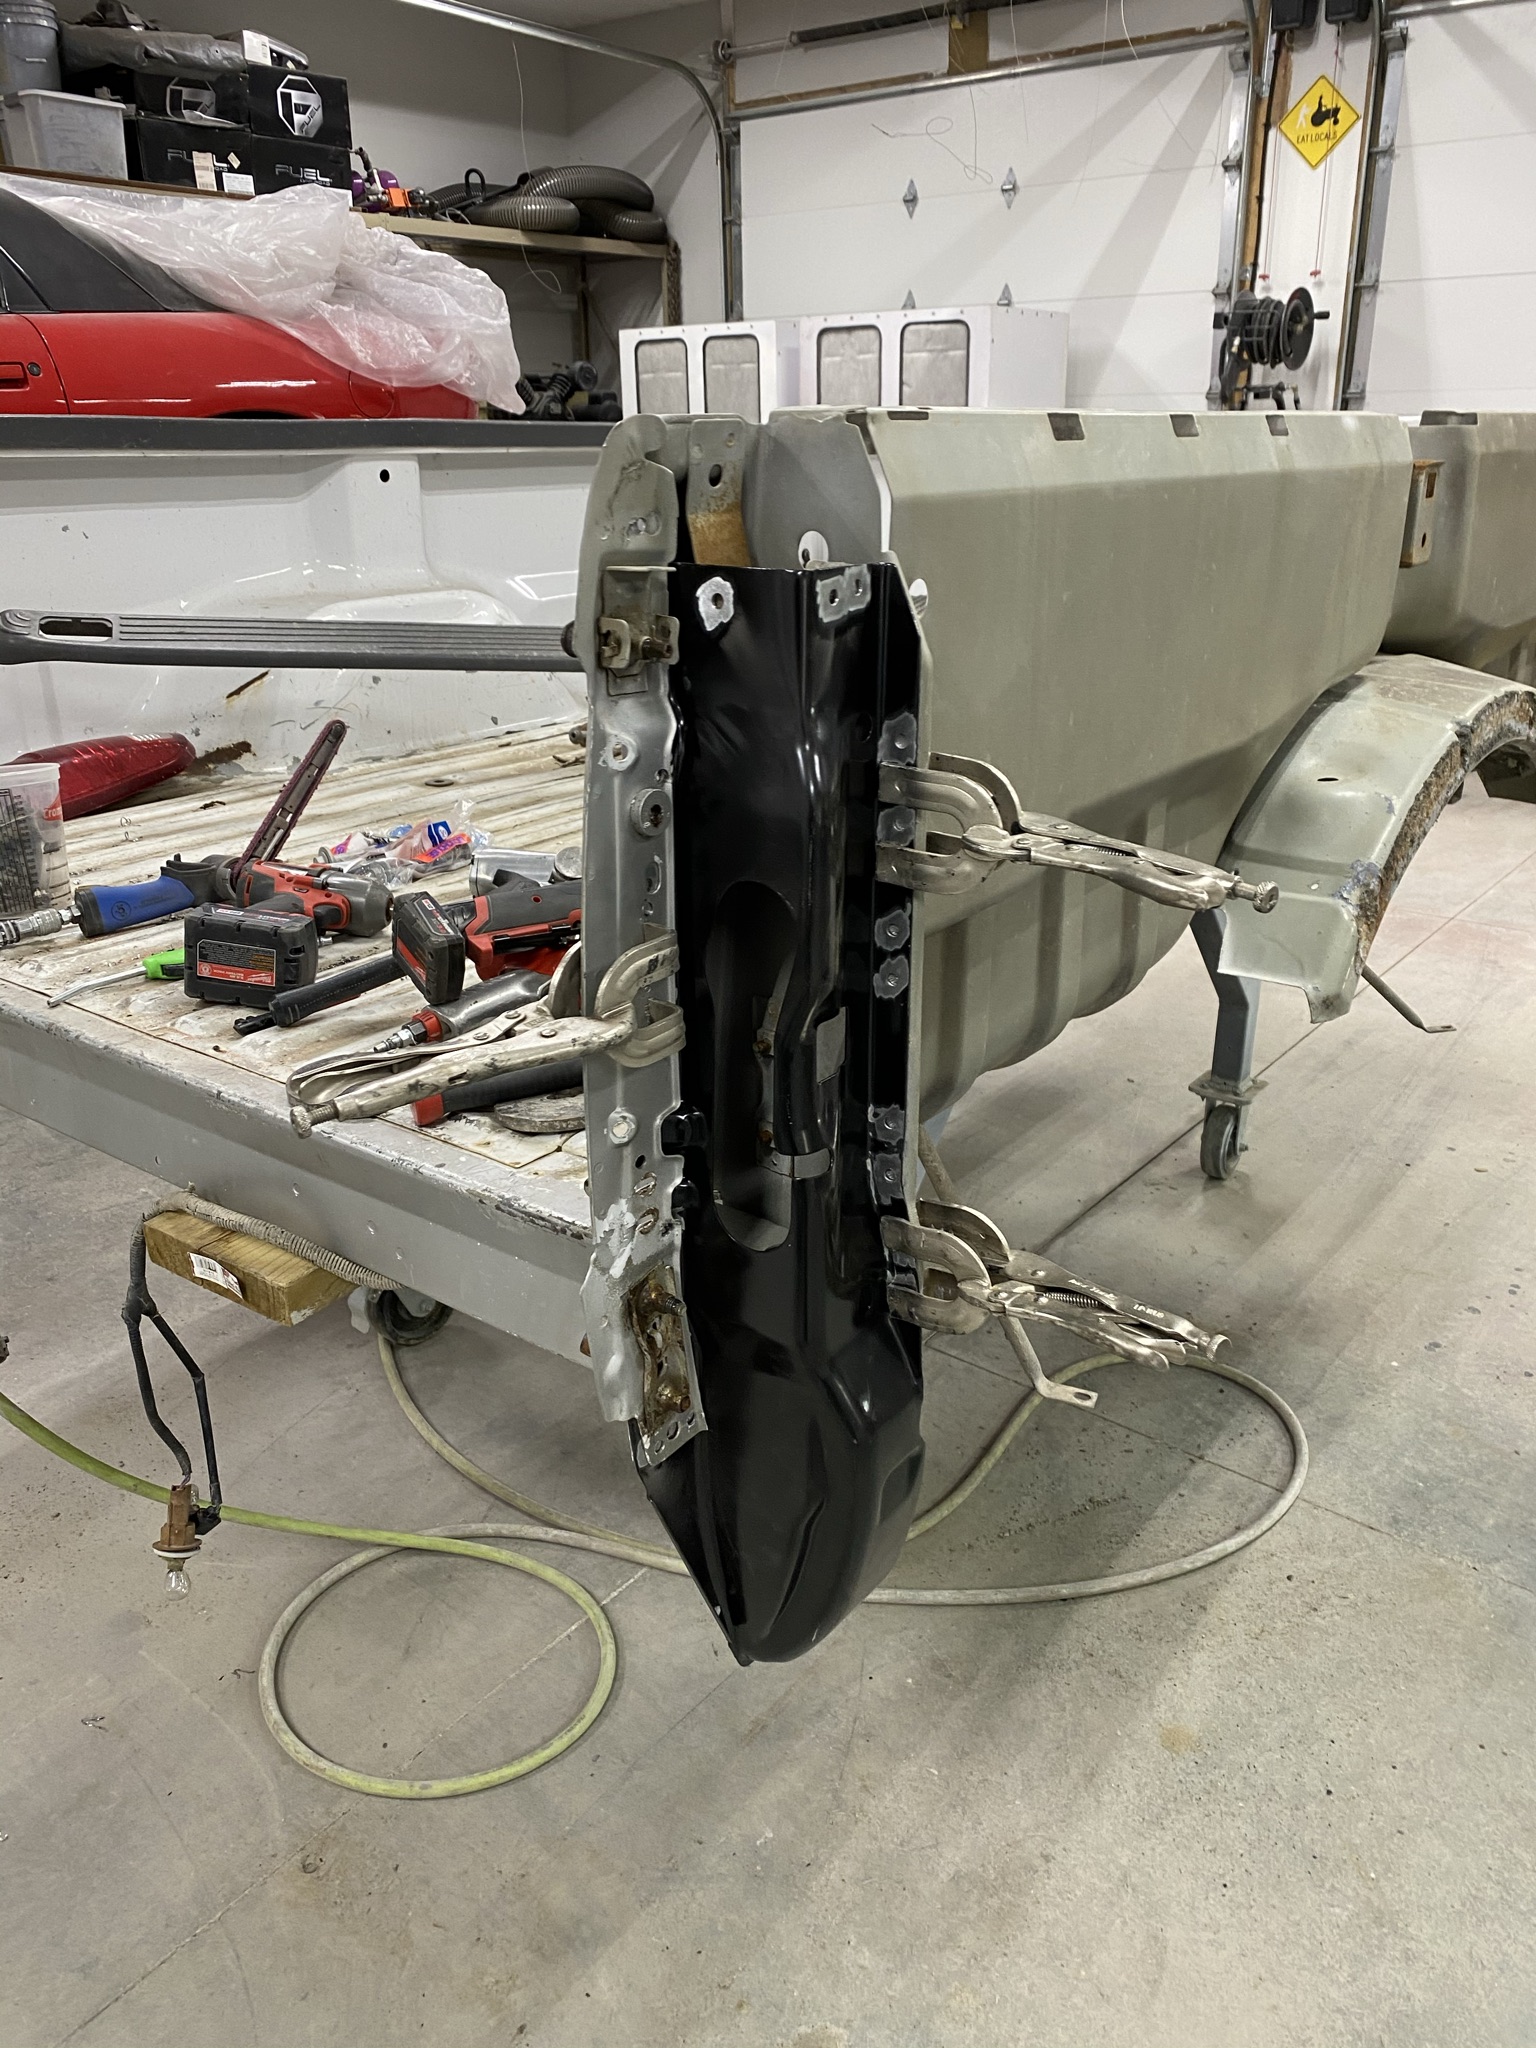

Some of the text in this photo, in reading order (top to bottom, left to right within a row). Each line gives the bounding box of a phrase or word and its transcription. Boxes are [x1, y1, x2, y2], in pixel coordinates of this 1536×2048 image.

[300, 105, 321, 134] FUEL
[1297, 130, 1338, 144] EAT LOCALS
[275, 164, 330, 182] FUEL
